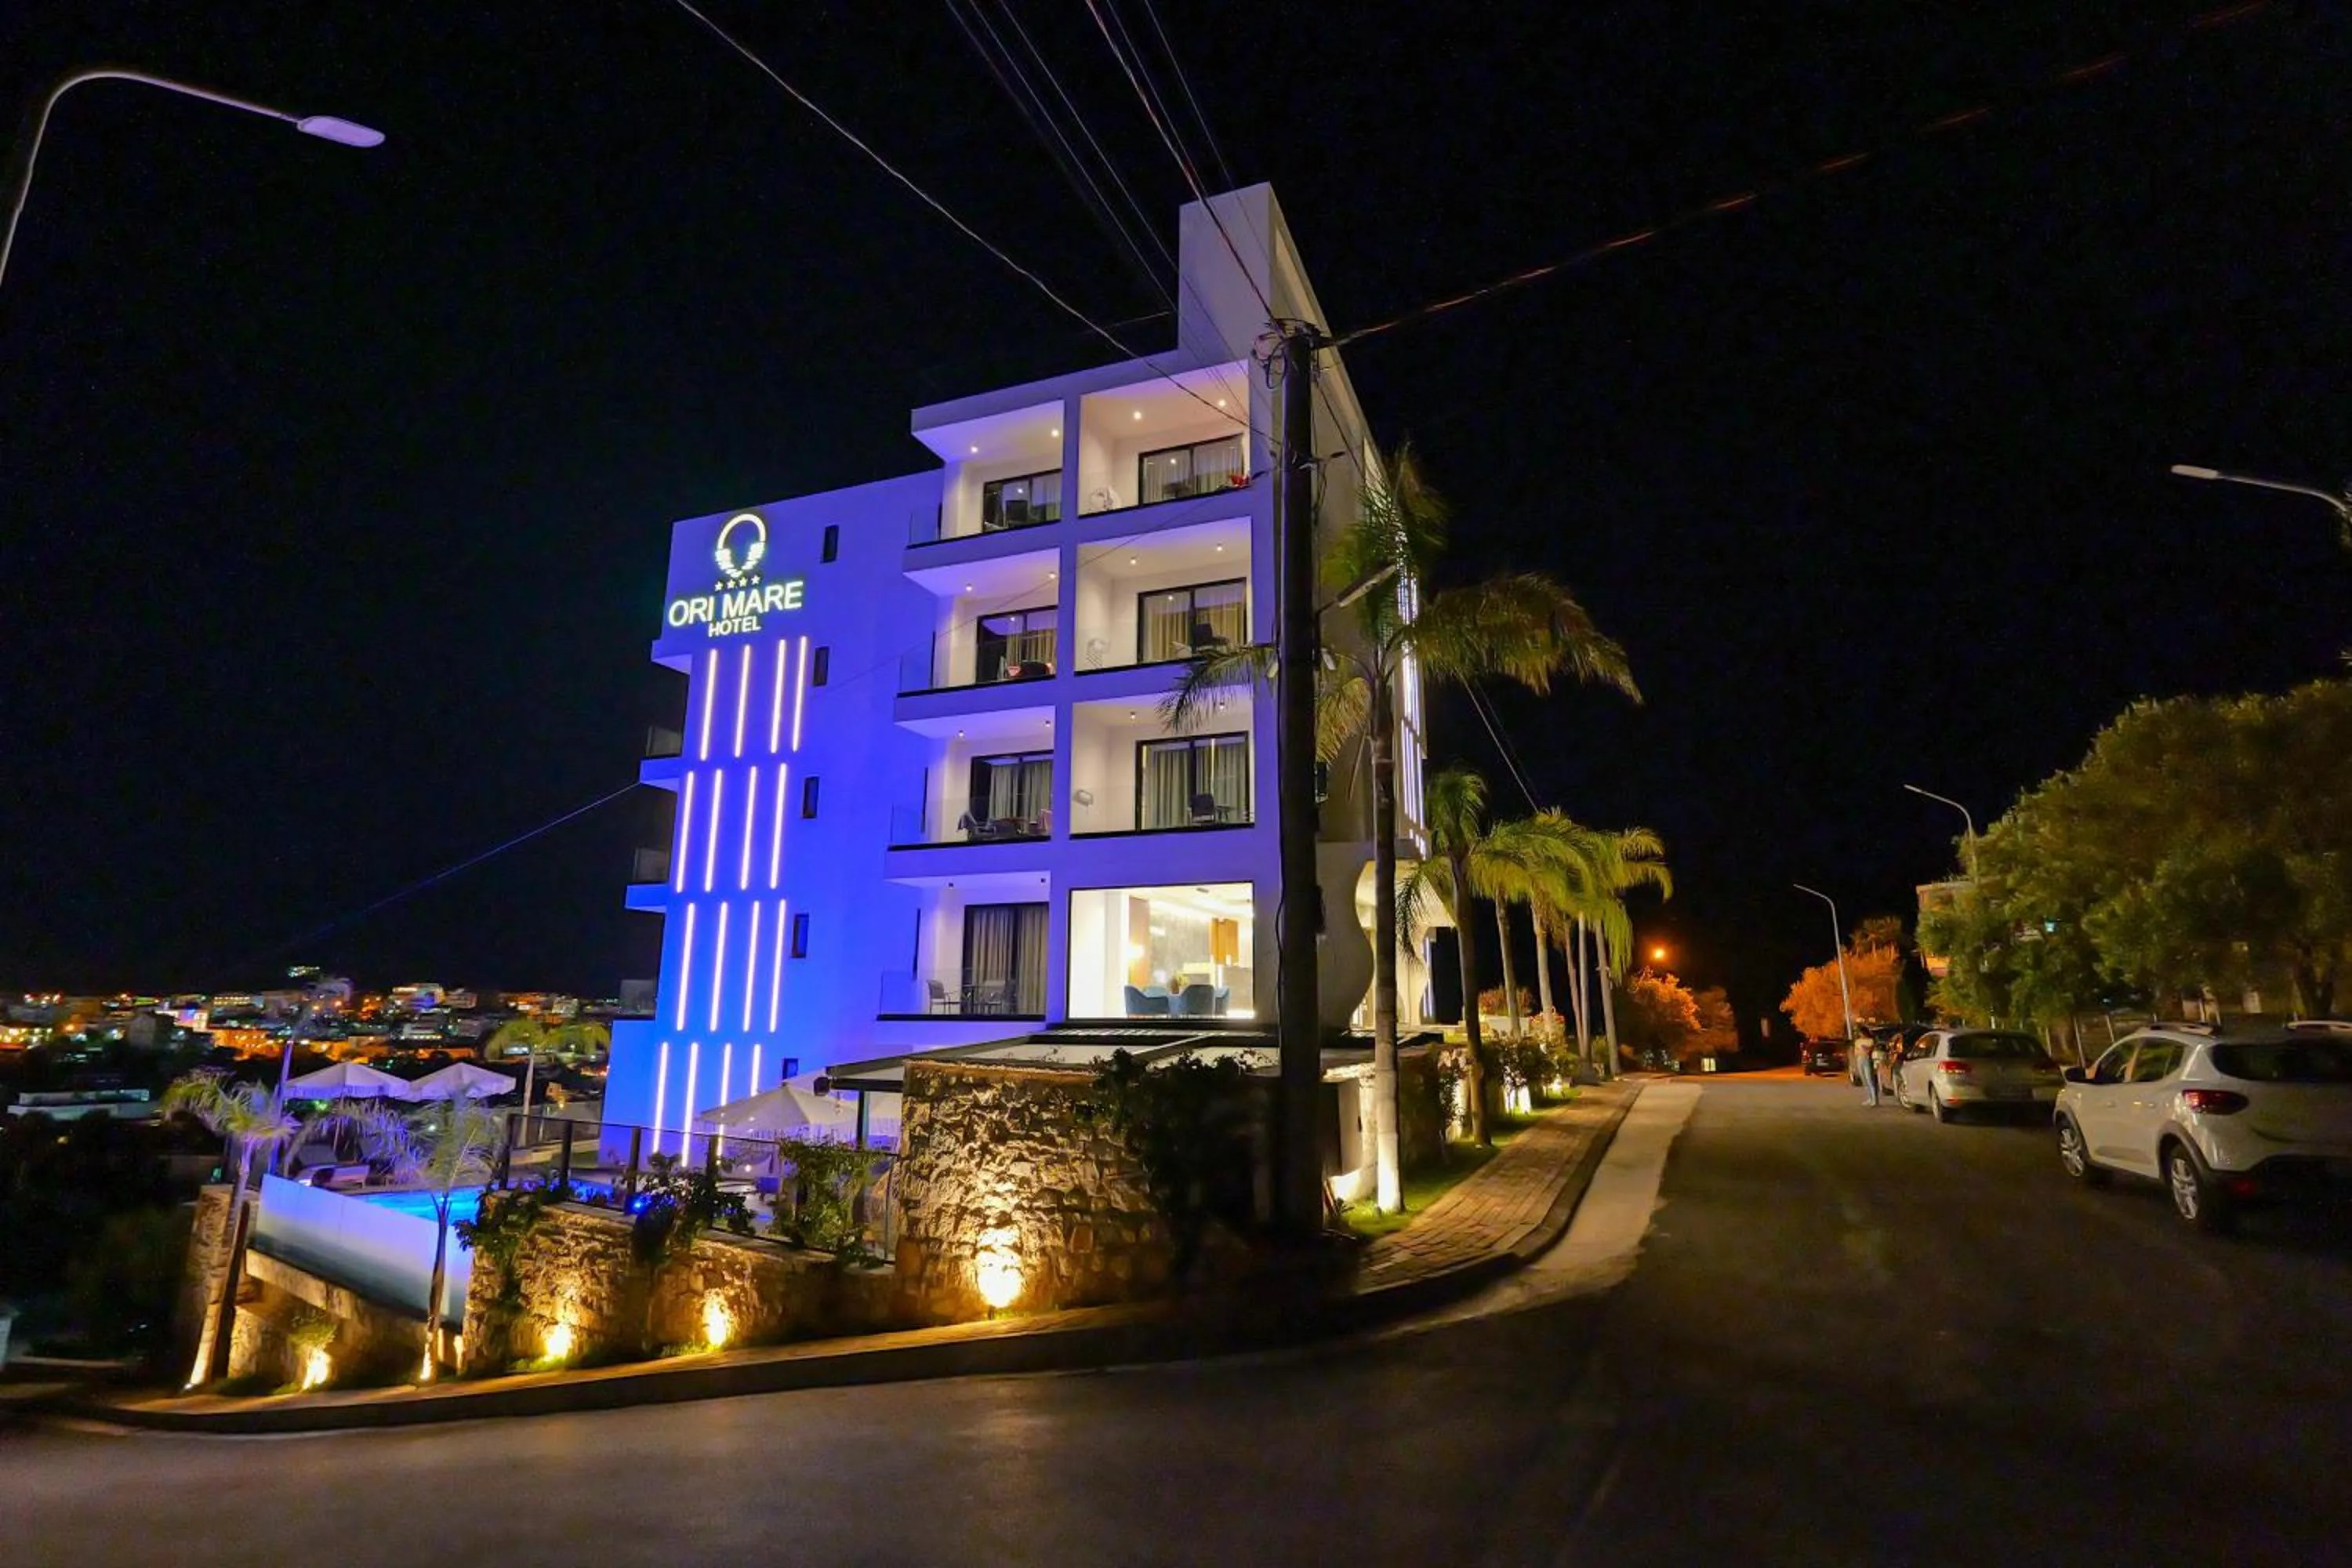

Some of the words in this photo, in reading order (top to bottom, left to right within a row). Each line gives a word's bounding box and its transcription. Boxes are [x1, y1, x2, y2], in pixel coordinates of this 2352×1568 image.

[669, 596, 714, 626] ORI
[722, 581, 804, 617] MARE
[708, 616, 761, 637] HOTEL
